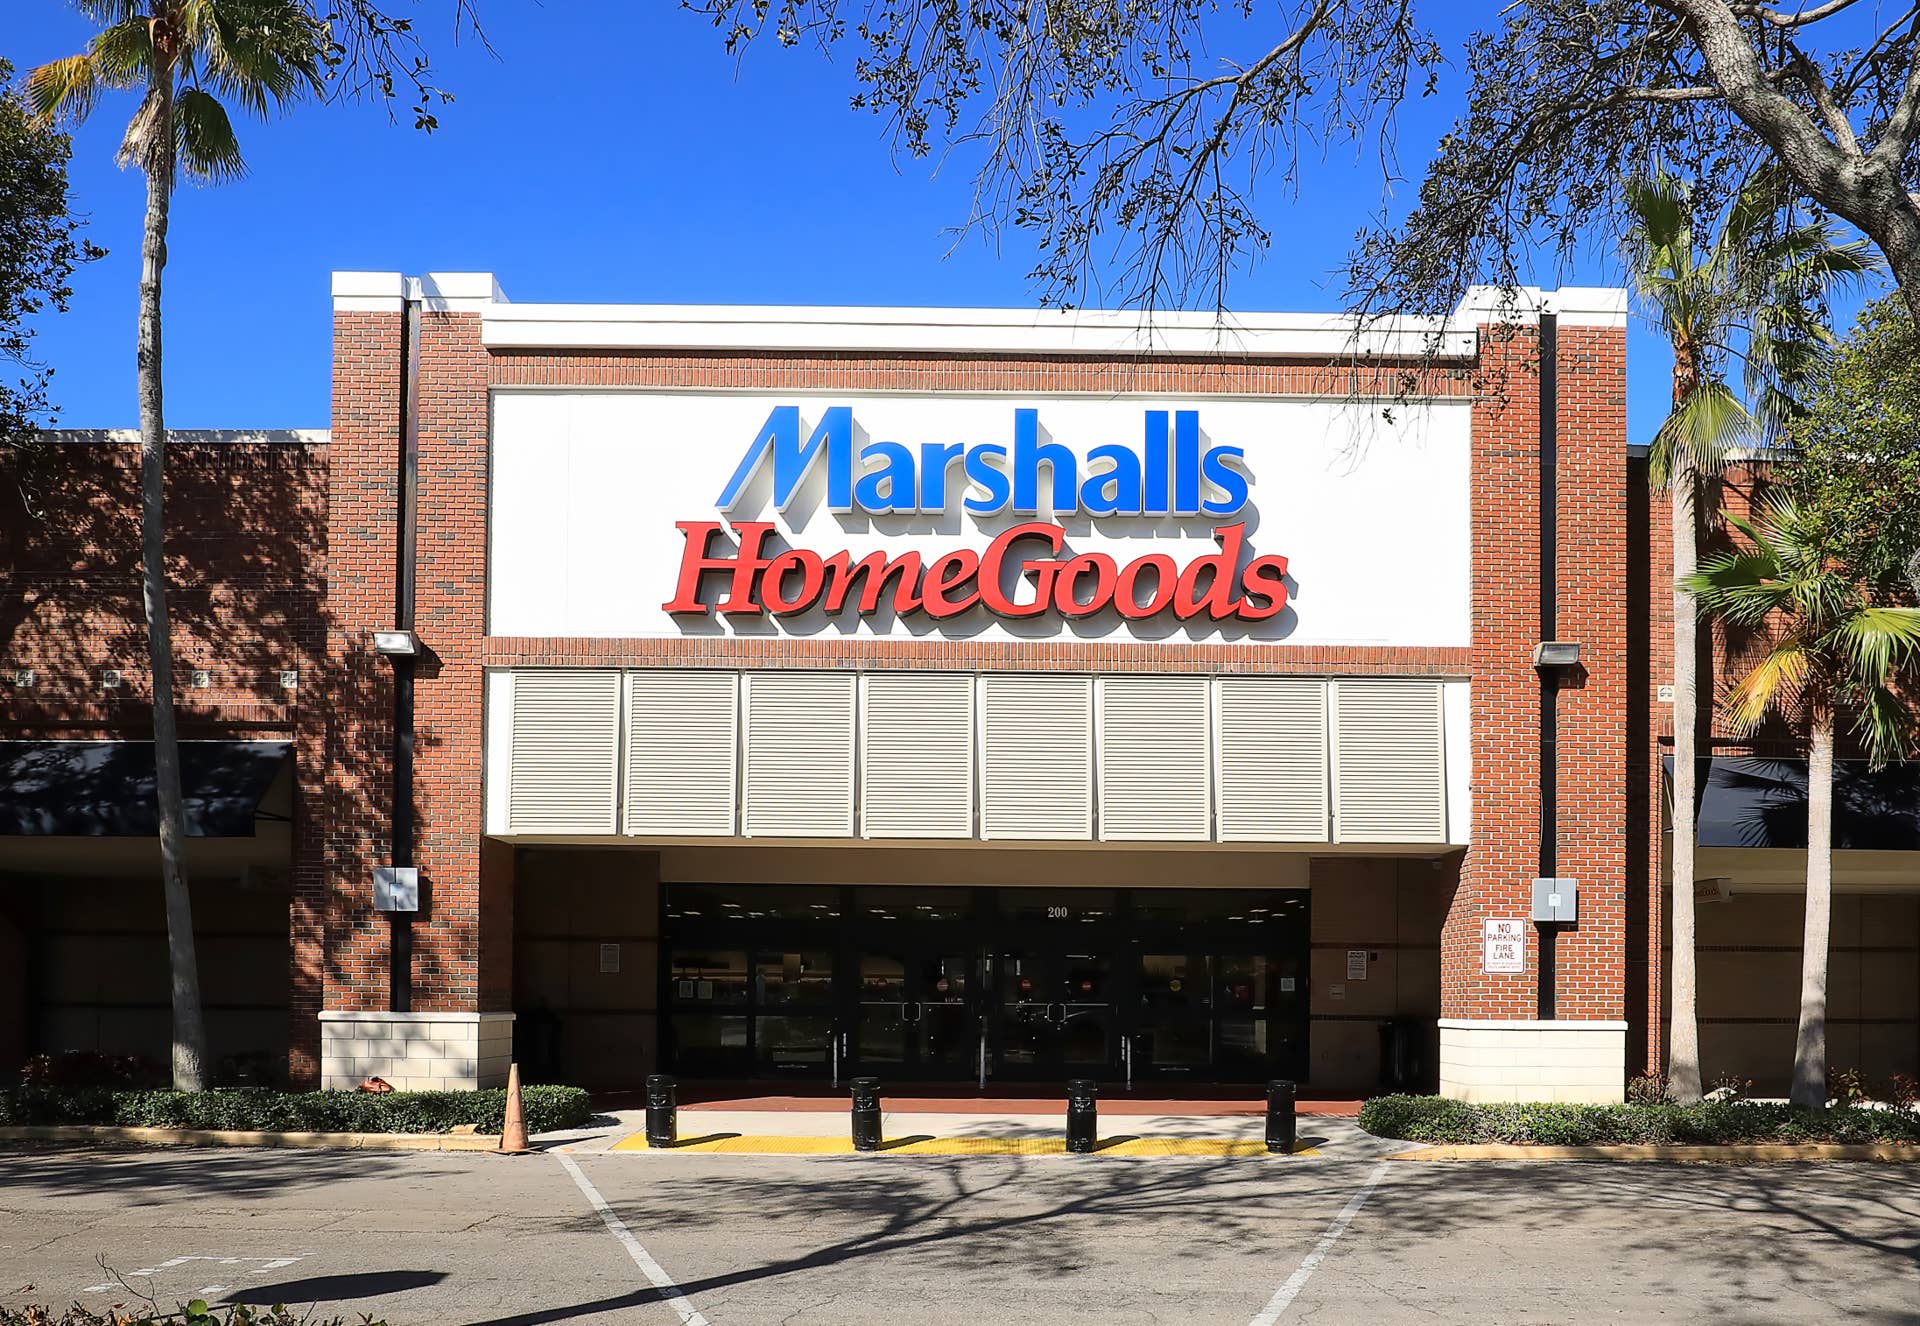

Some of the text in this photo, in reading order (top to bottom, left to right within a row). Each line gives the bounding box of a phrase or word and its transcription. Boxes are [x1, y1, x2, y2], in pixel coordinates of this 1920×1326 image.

[715, 405, 1249, 513] Marshalls
[662, 521, 1289, 619] HomeGoods
[1047, 906, 1068, 918] 200
[1498, 923, 1511, 933] NO
[1487, 934, 1521, 942] PARKING
